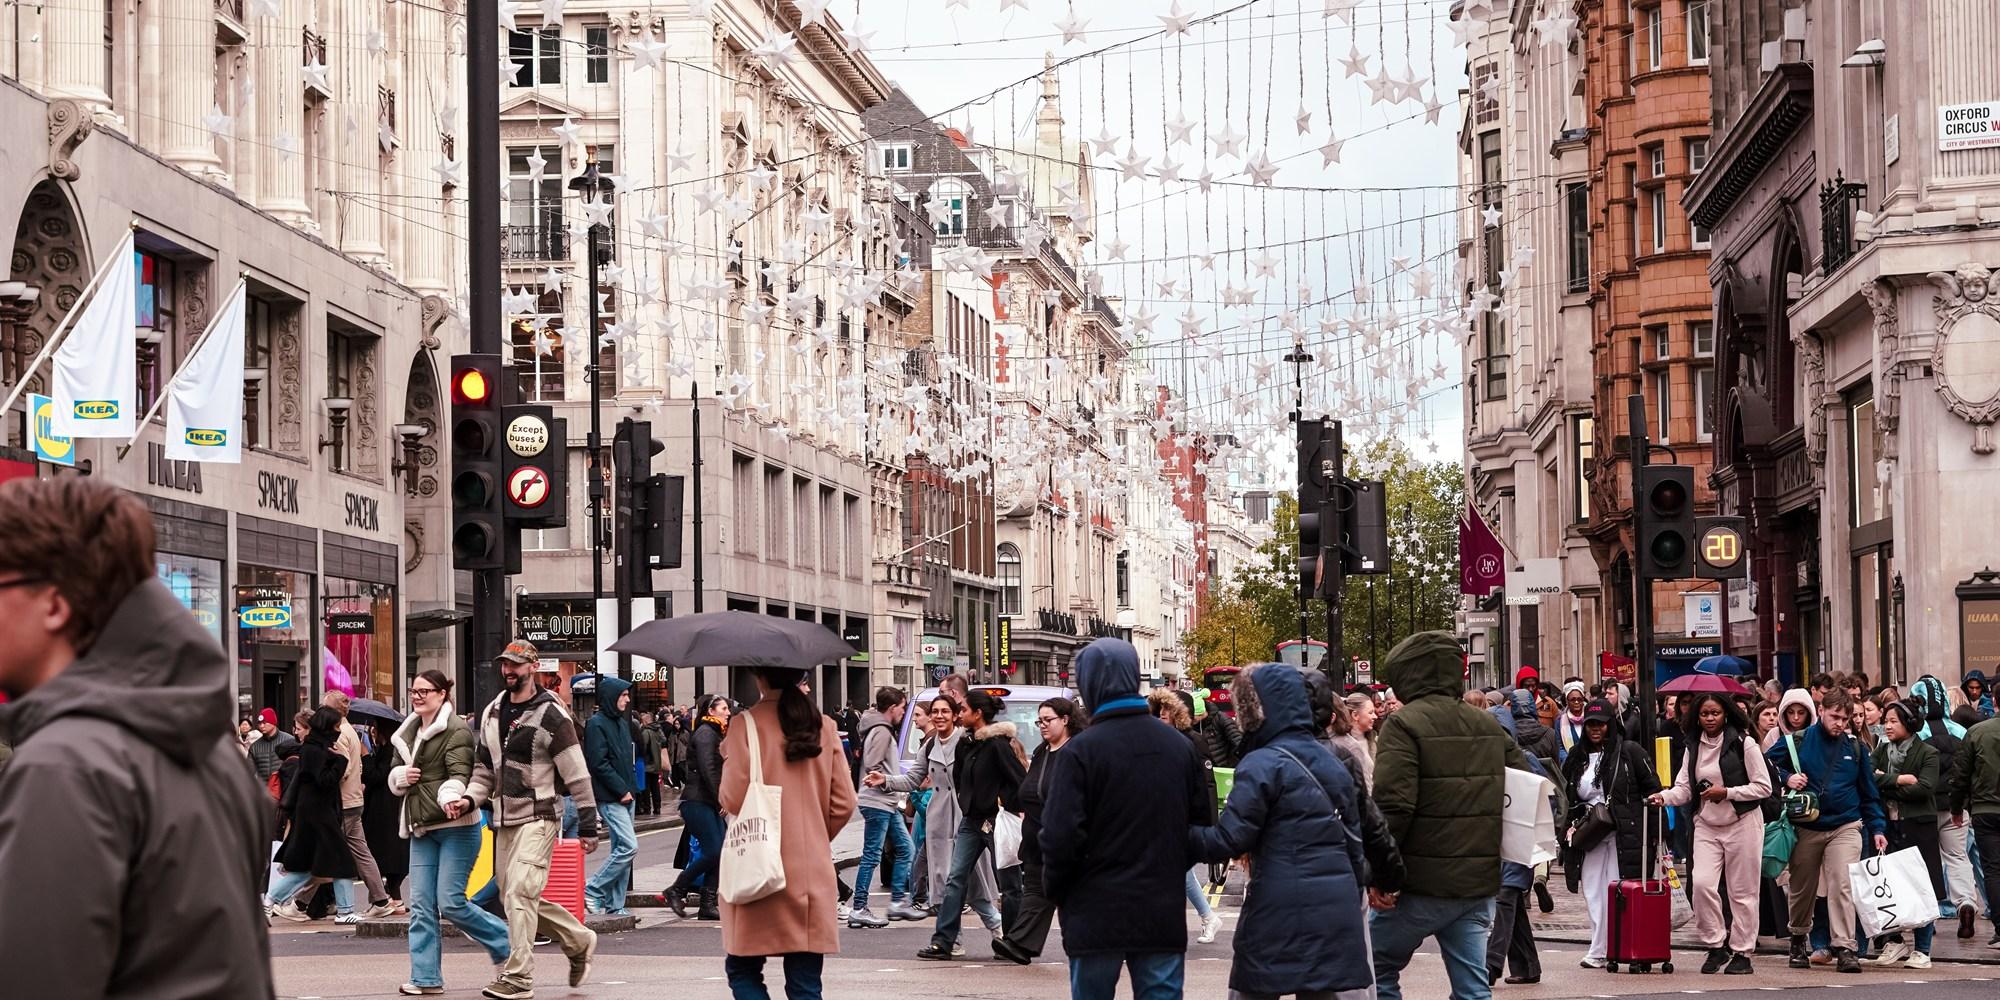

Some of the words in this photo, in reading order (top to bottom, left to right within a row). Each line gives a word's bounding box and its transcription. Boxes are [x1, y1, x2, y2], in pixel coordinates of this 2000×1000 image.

[1945, 107, 1990, 121] OXFORD
[1946, 121, 1987, 135] CIRCUS
[78, 405, 115, 414] IKEA
[38, 415, 70, 444] IK
[512, 425, 543, 434] Except
[189, 432, 223, 441] IKEA
[510, 434, 535, 442] buses
[515, 444, 537, 452] taxis
[148, 441, 203, 494] IKEA
[1706, 535, 1736, 560] 20
[245, 612, 286, 621] IKEA
[1967, 614, 2000, 622] IUMA
[550, 616, 595, 635] OUTF
[527, 632, 548, 640] VANS
